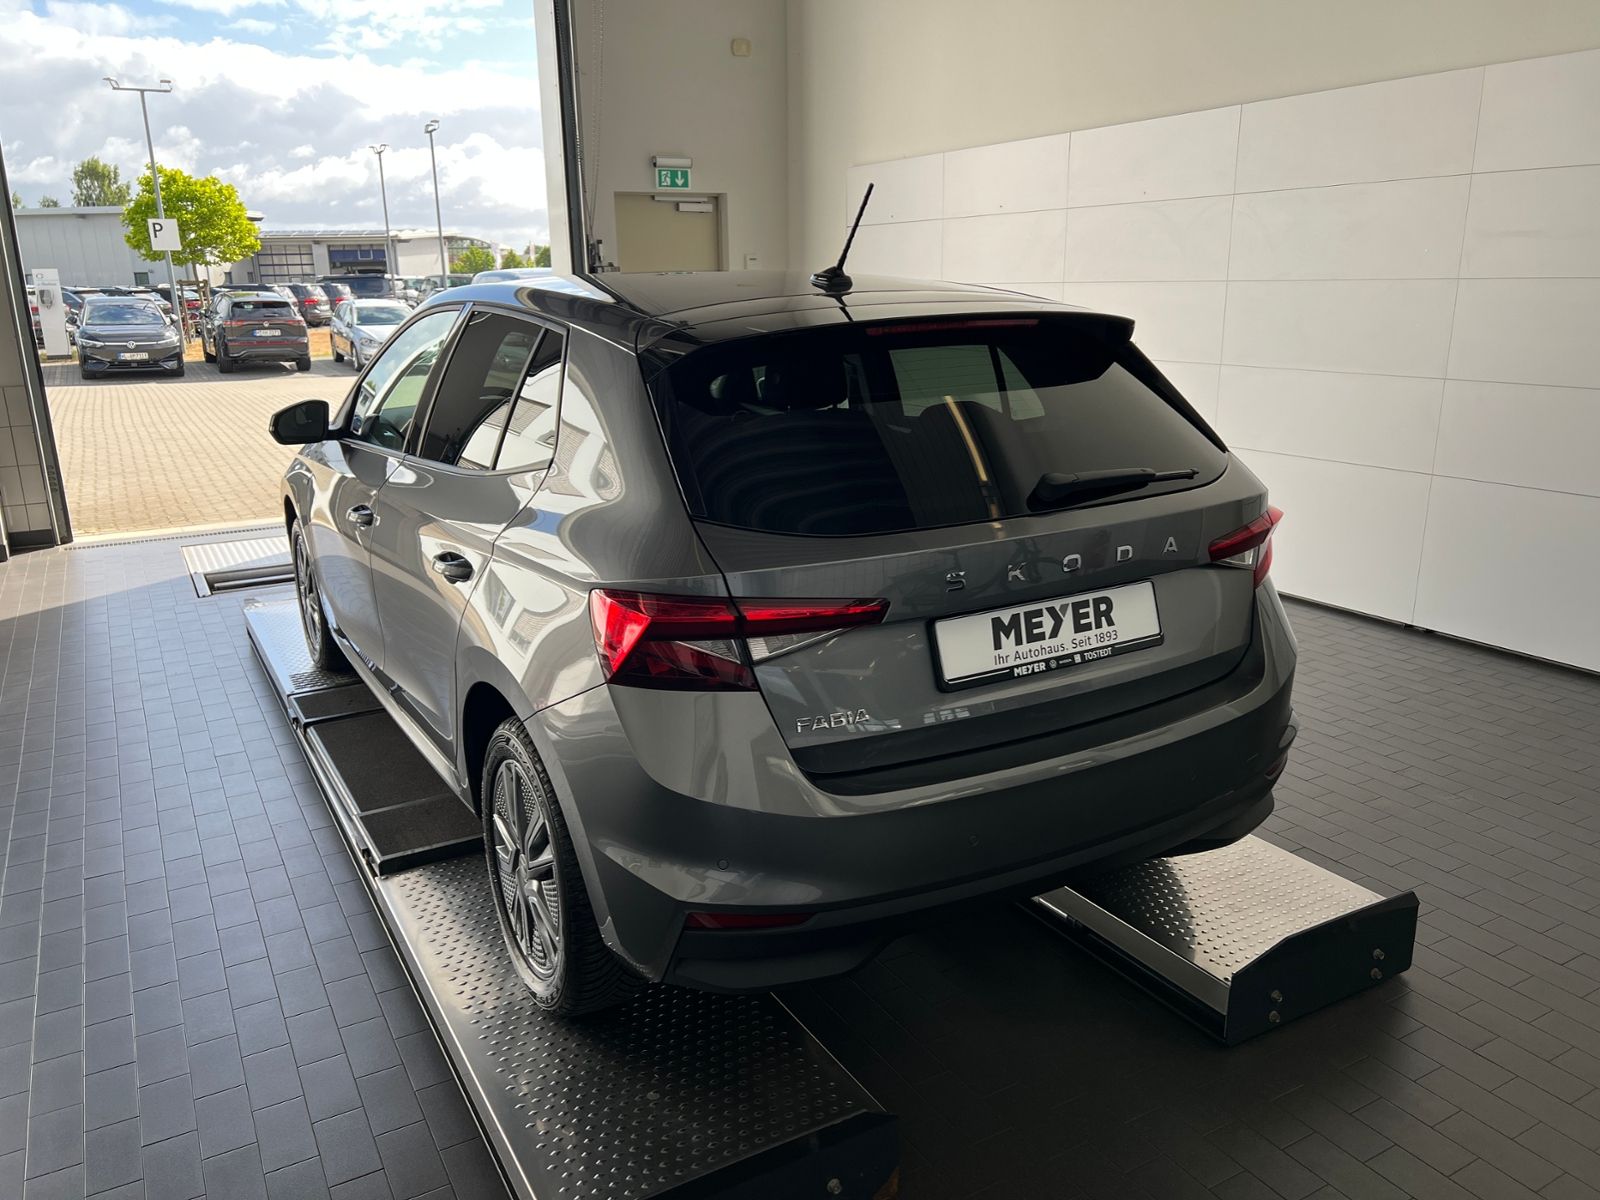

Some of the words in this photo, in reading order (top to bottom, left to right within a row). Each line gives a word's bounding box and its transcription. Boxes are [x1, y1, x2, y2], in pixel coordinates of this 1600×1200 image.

[152, 222, 164, 238] P
[991, 595, 1115, 651] MEYER
[994, 653, 1010, 666] Ihr
[1014, 643, 1069, 661] Autohaus.
[1071, 636, 1092, 650] Seit
[1095, 630, 1119, 644] 1893
[1013, 662, 1046, 677] MEYER
[1083, 647, 1112, 661] TOSTEDT
[796, 708, 870, 733] FABIA
